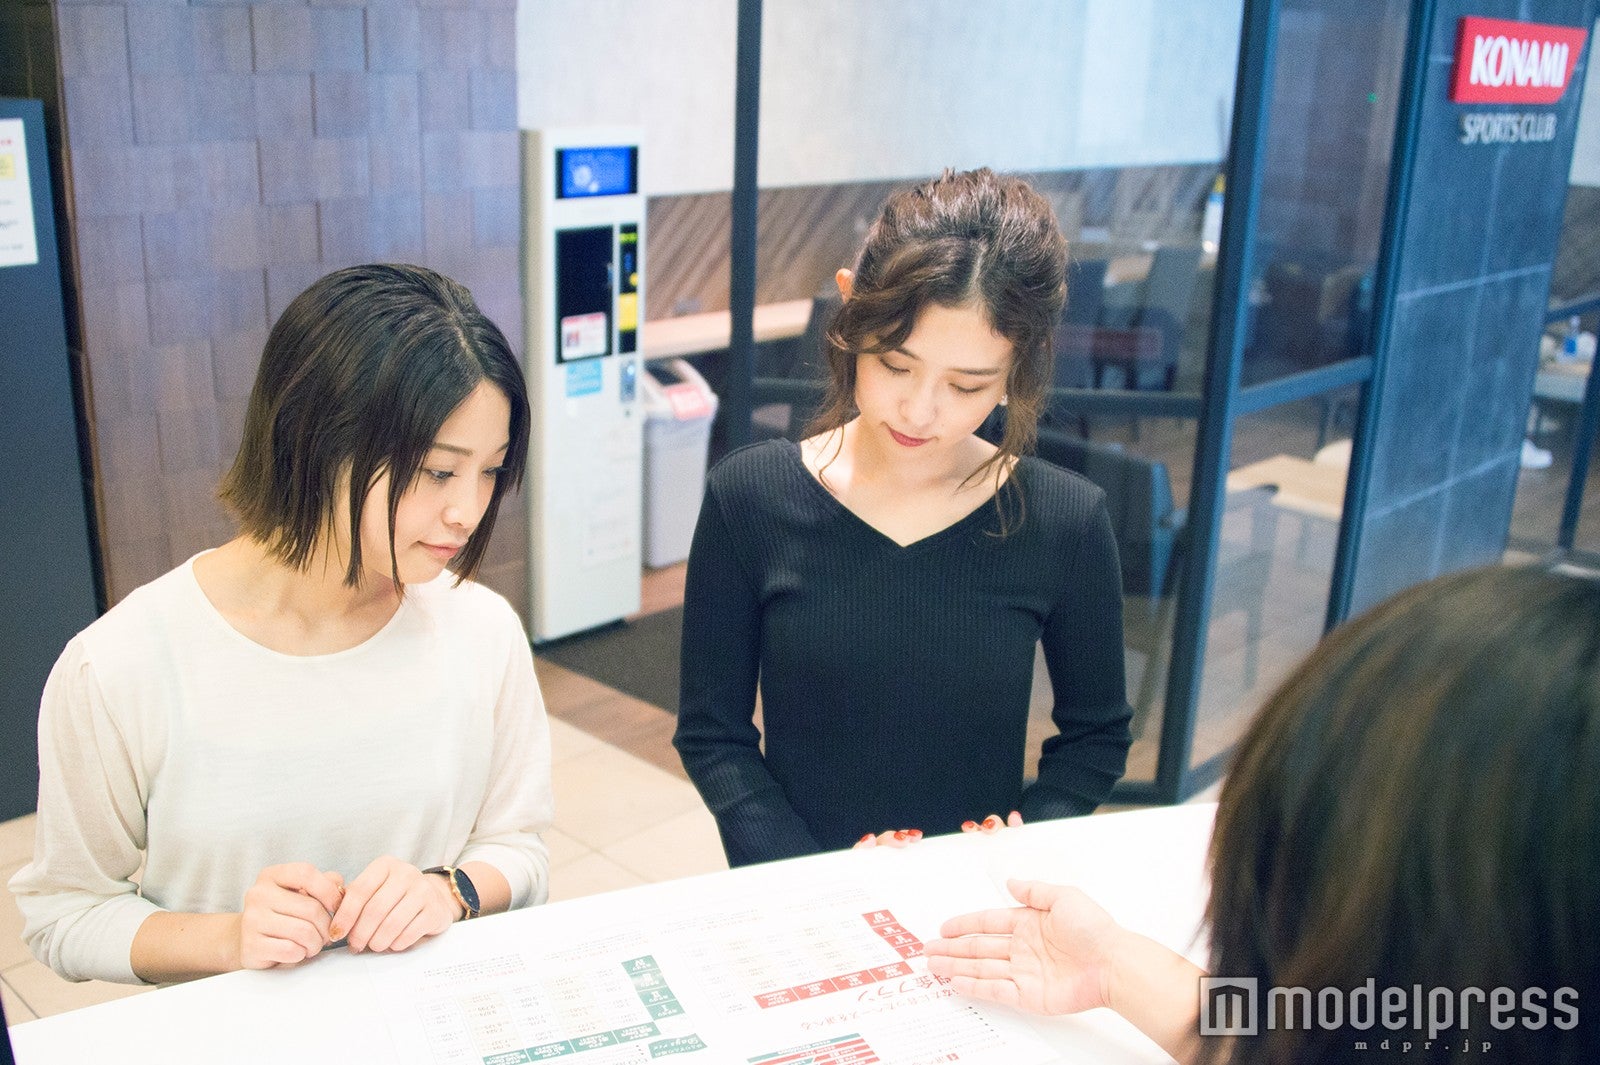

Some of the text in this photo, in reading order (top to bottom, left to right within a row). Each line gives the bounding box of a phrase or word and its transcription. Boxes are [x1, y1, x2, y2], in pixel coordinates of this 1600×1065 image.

[1470, 34, 1569, 88] KONAMI
[1461, 112, 1558, 144] SPORTS CLUB
